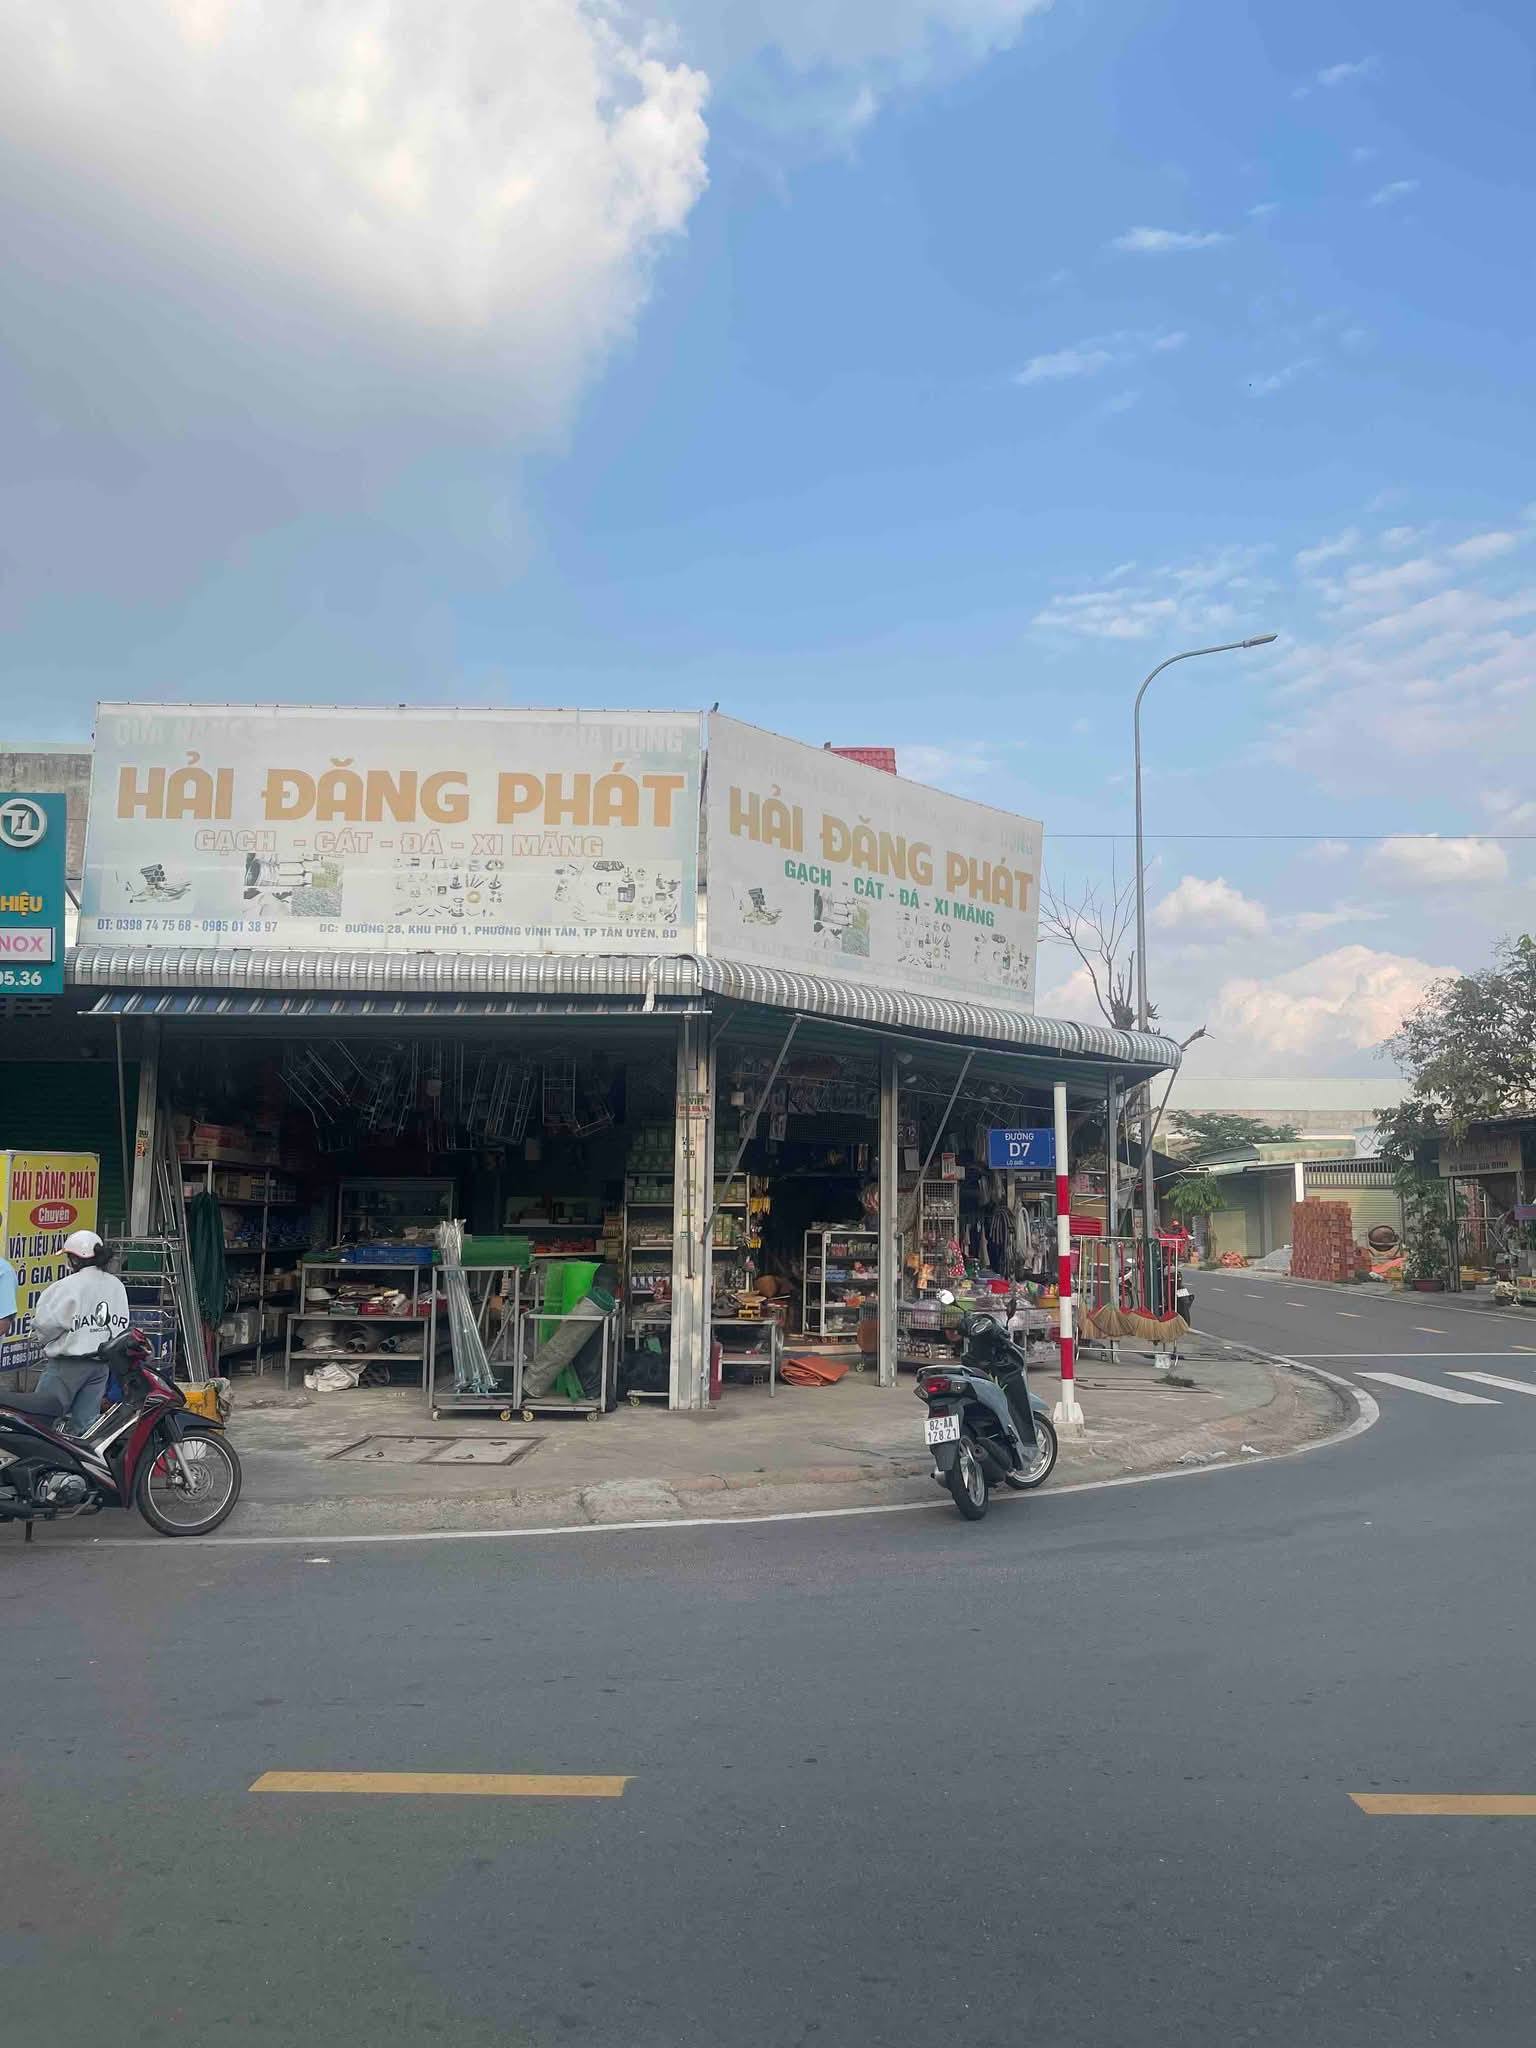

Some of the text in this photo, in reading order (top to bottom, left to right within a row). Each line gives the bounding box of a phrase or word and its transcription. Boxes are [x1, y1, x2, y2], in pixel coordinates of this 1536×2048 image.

[117, 751, 234, 820] HẢI
[261, 758, 470, 824] ĐĂNG
[497, 762, 685, 827] PHÁT
[195, 829, 276, 856] GẠCH
[315, 828, 373, 853] CÁT
[400, 829, 443, 854] ĐÁ
[472, 833, 504, 855] XI
[512, 831, 603, 858] MĂNG
[729, 784, 1033, 912] HẢI ĐĂNG PHÁT
[784, 860, 831, 887] GẠCH
[854, 876, 884, 900] CÁT
[899, 888, 919, 909] ĐÁ
[935, 898, 949, 917] XI
[953, 902, 994, 928] MĂNG
[116, 919, 142, 931] 0398
[145, 920, 158, 931] 74
[162, 920, 175, 931] 75
[178, 920, 191, 931] 68
[202, 920, 228, 932] 0985
[231, 921, 243, 932] 01
[248, 921, 261, 932] 38
[264, 921, 278, 932] 97
[408, 924, 431, 934] KHU
[584, 927, 597, 937] TP
[600, 926, 622, 937] TÂN
[1009, 1142, 1030, 1157] D7
[12, 1161, 96, 1200] HẢI ĐĂNG PHÁT
[38, 1206, 70, 1223] Chuyên
[9, 1232, 27, 1263] VẬT
[29, 1231, 49, 1262] LIỆU
[16, 1262, 26, 1286] Ồ
[31, 1265, 53, 1284] GIA
